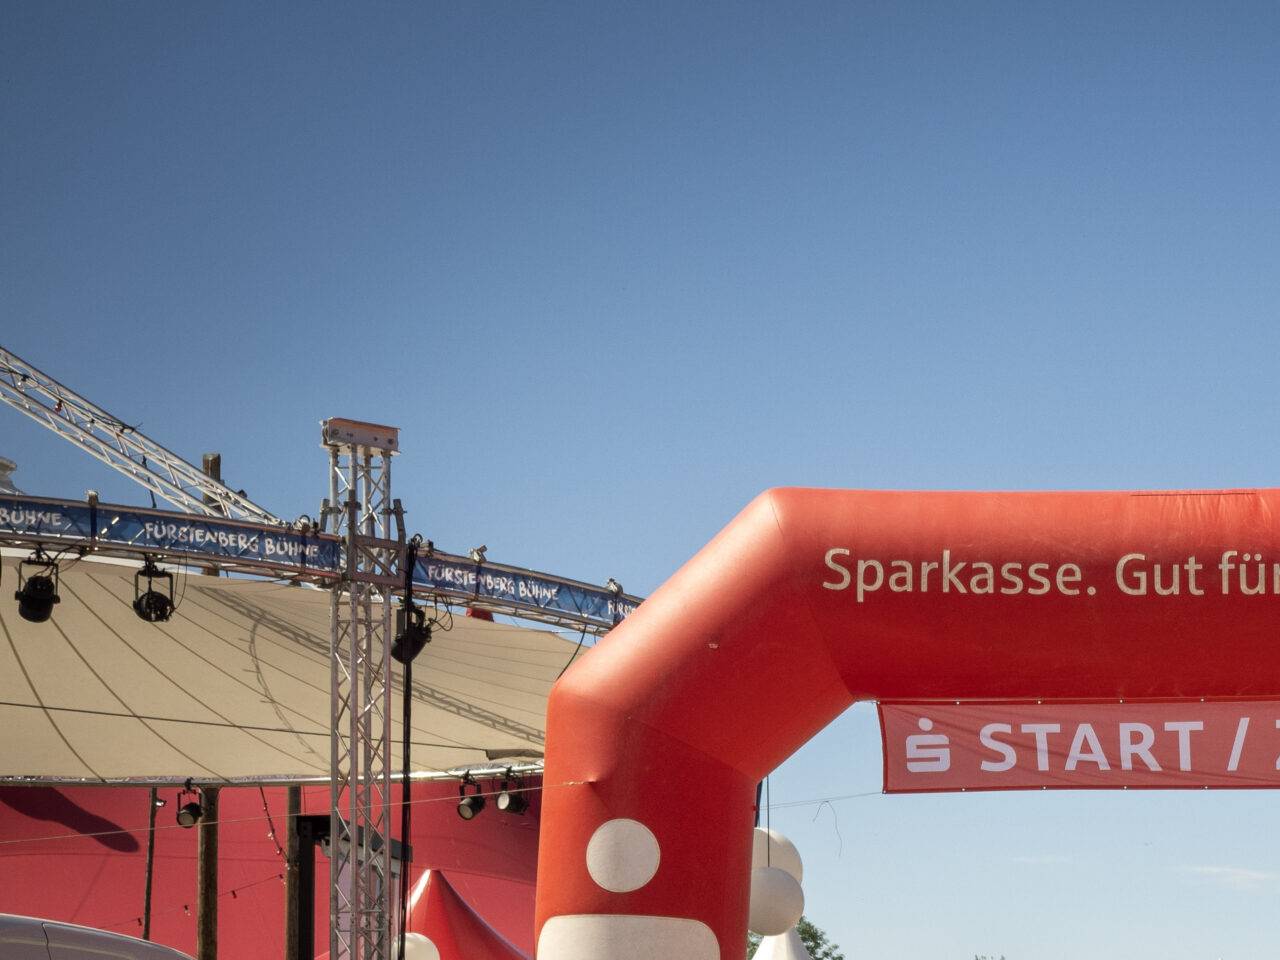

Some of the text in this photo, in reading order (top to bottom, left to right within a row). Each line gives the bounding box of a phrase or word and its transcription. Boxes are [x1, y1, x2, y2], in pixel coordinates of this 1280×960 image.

[145, 521, 319, 558] FÜRSTENBERG BÜHNE
[427, 565, 559, 601] FÜRSTENBERG BÜHNE
[822, 547, 1097, 602] Sparkasse.
[1115, 550, 1204, 597] Gut
[979, 720, 1204, 773] START
[1227, 716, 1251, 772] /
